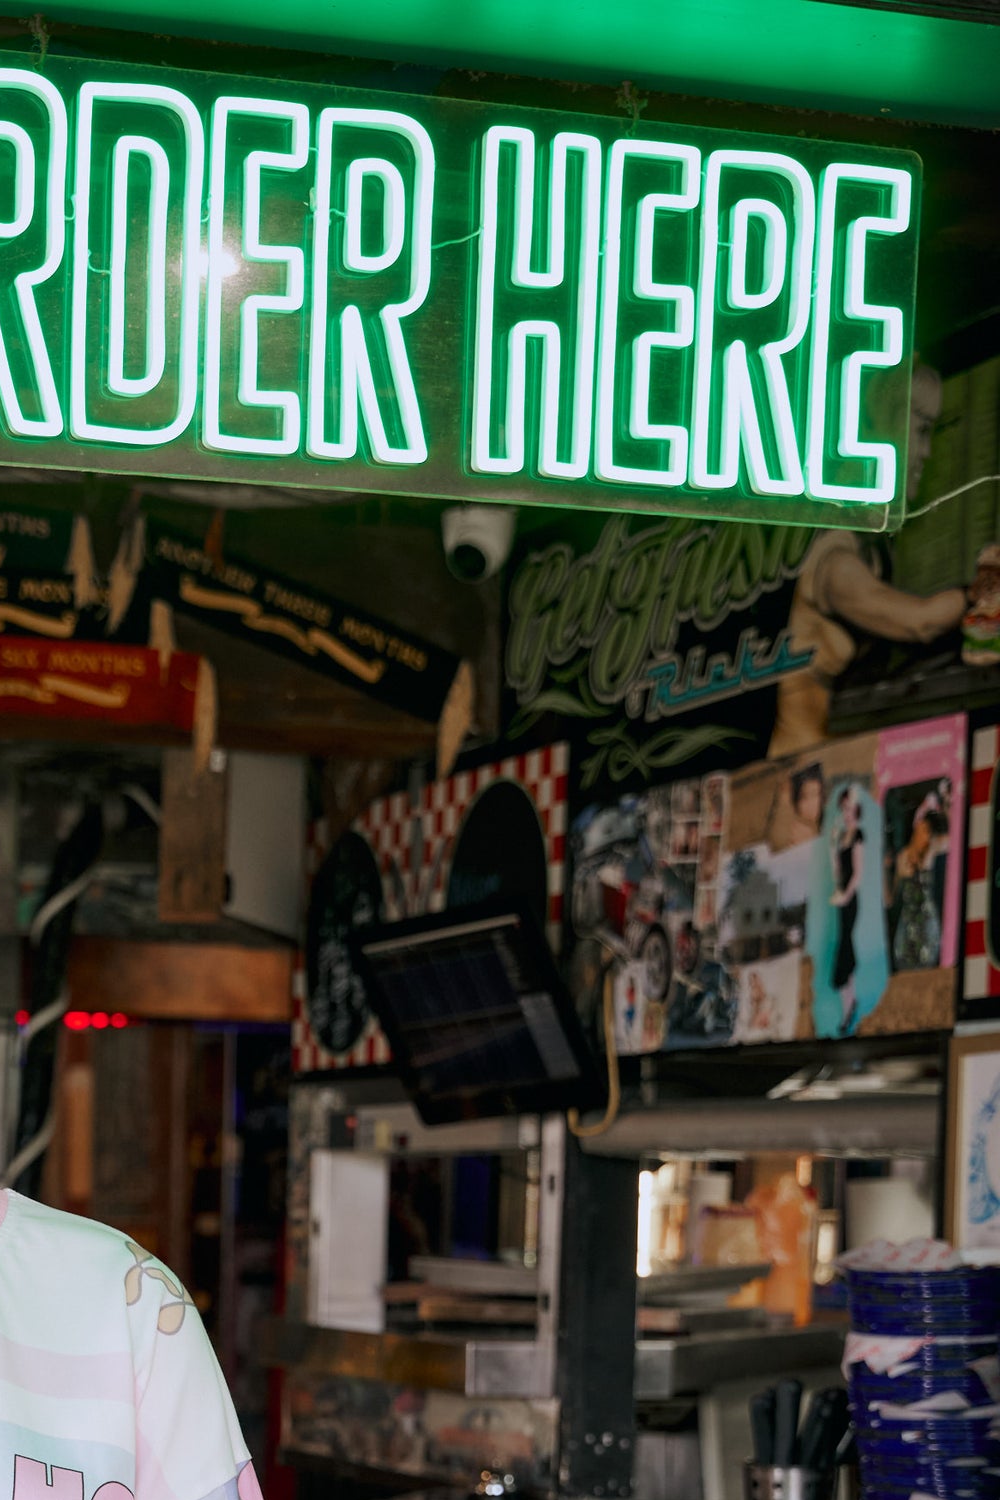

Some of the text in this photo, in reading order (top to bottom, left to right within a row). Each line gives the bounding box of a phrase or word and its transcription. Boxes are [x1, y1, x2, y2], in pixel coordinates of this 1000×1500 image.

[470, 125, 912, 504] HERE
[0, 644, 40, 670] SIX
[47, 649, 148, 677] MONTHS
[338, 615, 431, 673] MONTHS
